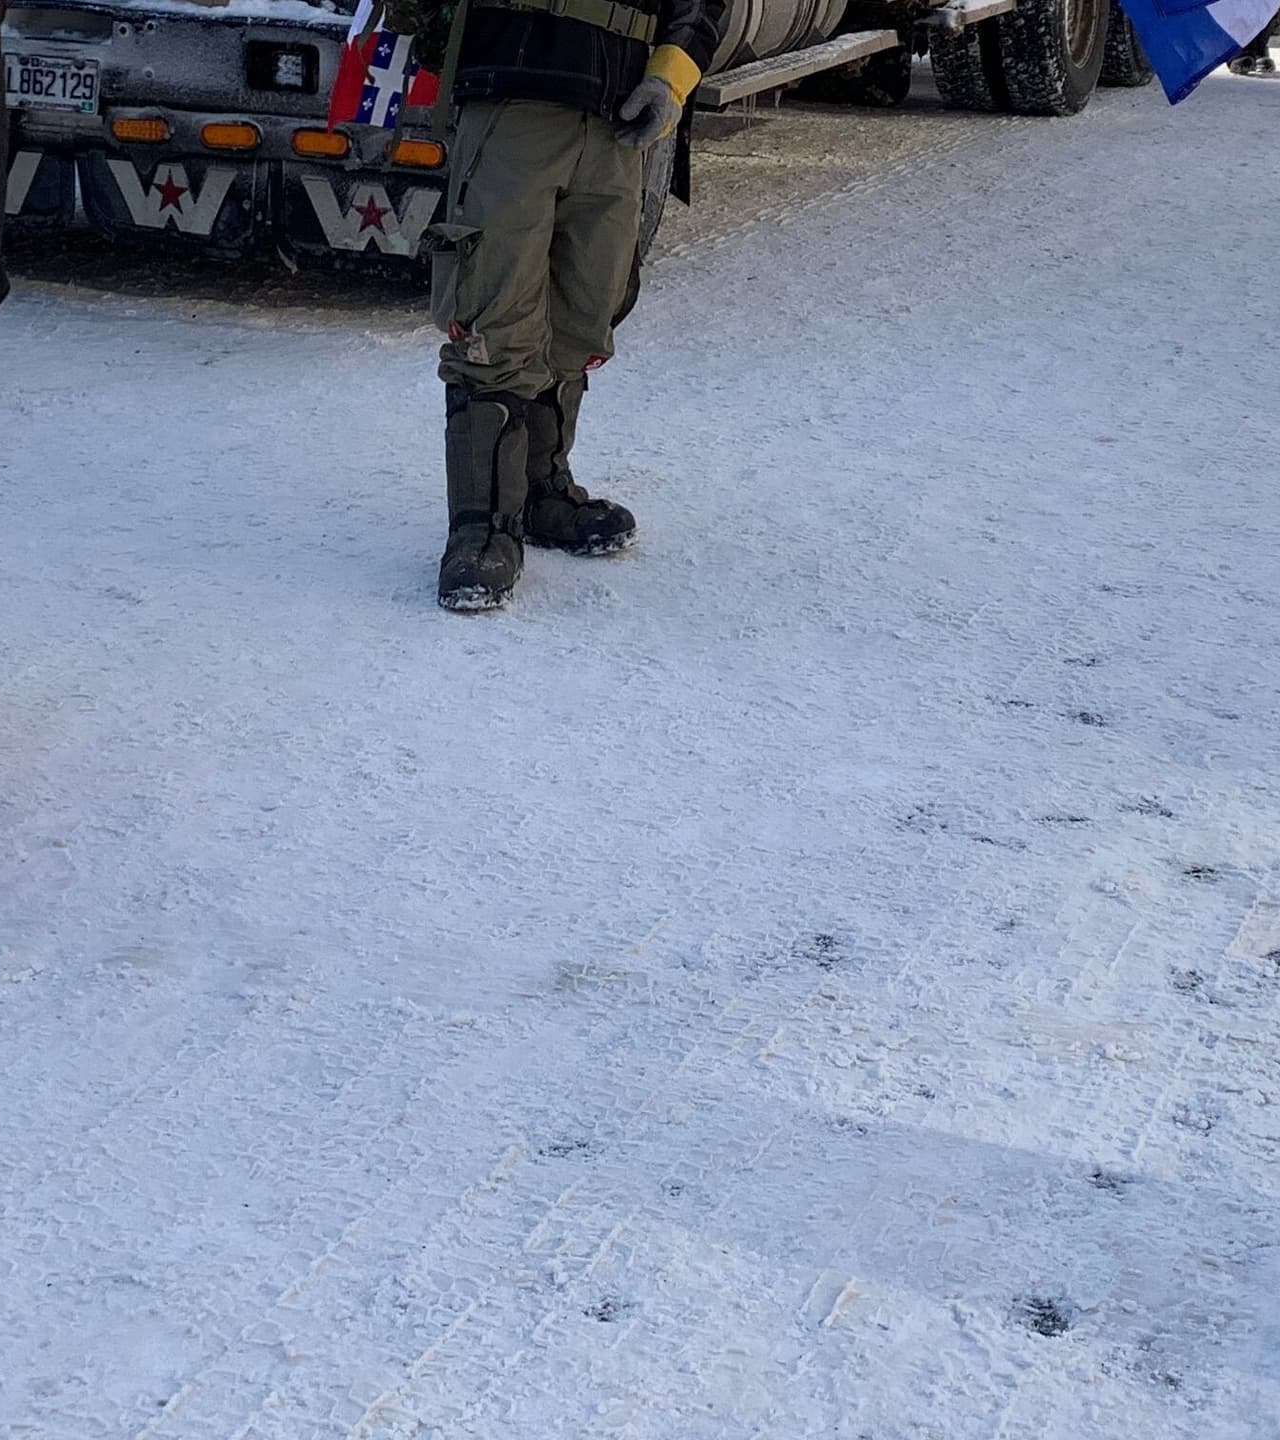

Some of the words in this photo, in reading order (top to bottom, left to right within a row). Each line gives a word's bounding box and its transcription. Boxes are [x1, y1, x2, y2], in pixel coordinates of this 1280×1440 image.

[6, 67, 94, 100] L862129
[107, 159, 238, 235] W
[301, 175, 442, 258] W
